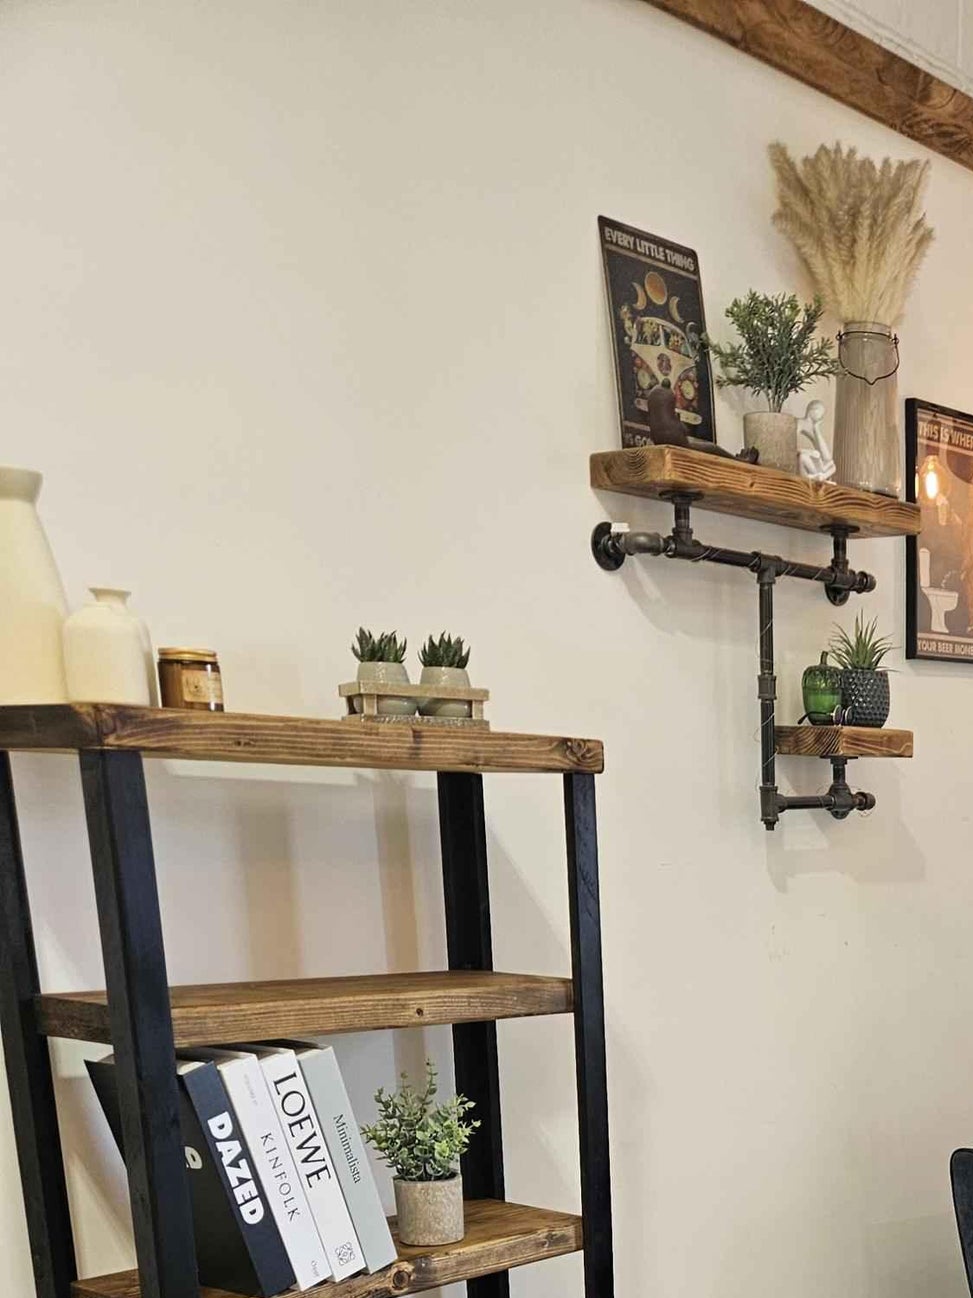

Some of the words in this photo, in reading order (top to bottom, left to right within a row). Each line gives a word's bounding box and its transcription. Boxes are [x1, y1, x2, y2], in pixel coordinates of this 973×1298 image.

[604, 226, 634, 250] EVERY
[636, 238, 666, 261] LITTLE
[665, 248, 695, 272] THING
[918, 421, 939, 441] THIS
[940, 426, 950, 443] IS
[917, 640, 937, 652] YOUR
[937, 642, 954, 654] BEER
[273, 1071, 331, 1189] LOEWE
[333, 1113, 361, 1184] Minimalista
[207, 1111, 265, 1225] DAZED
[260, 1132, 301, 1222] KINFOLK
